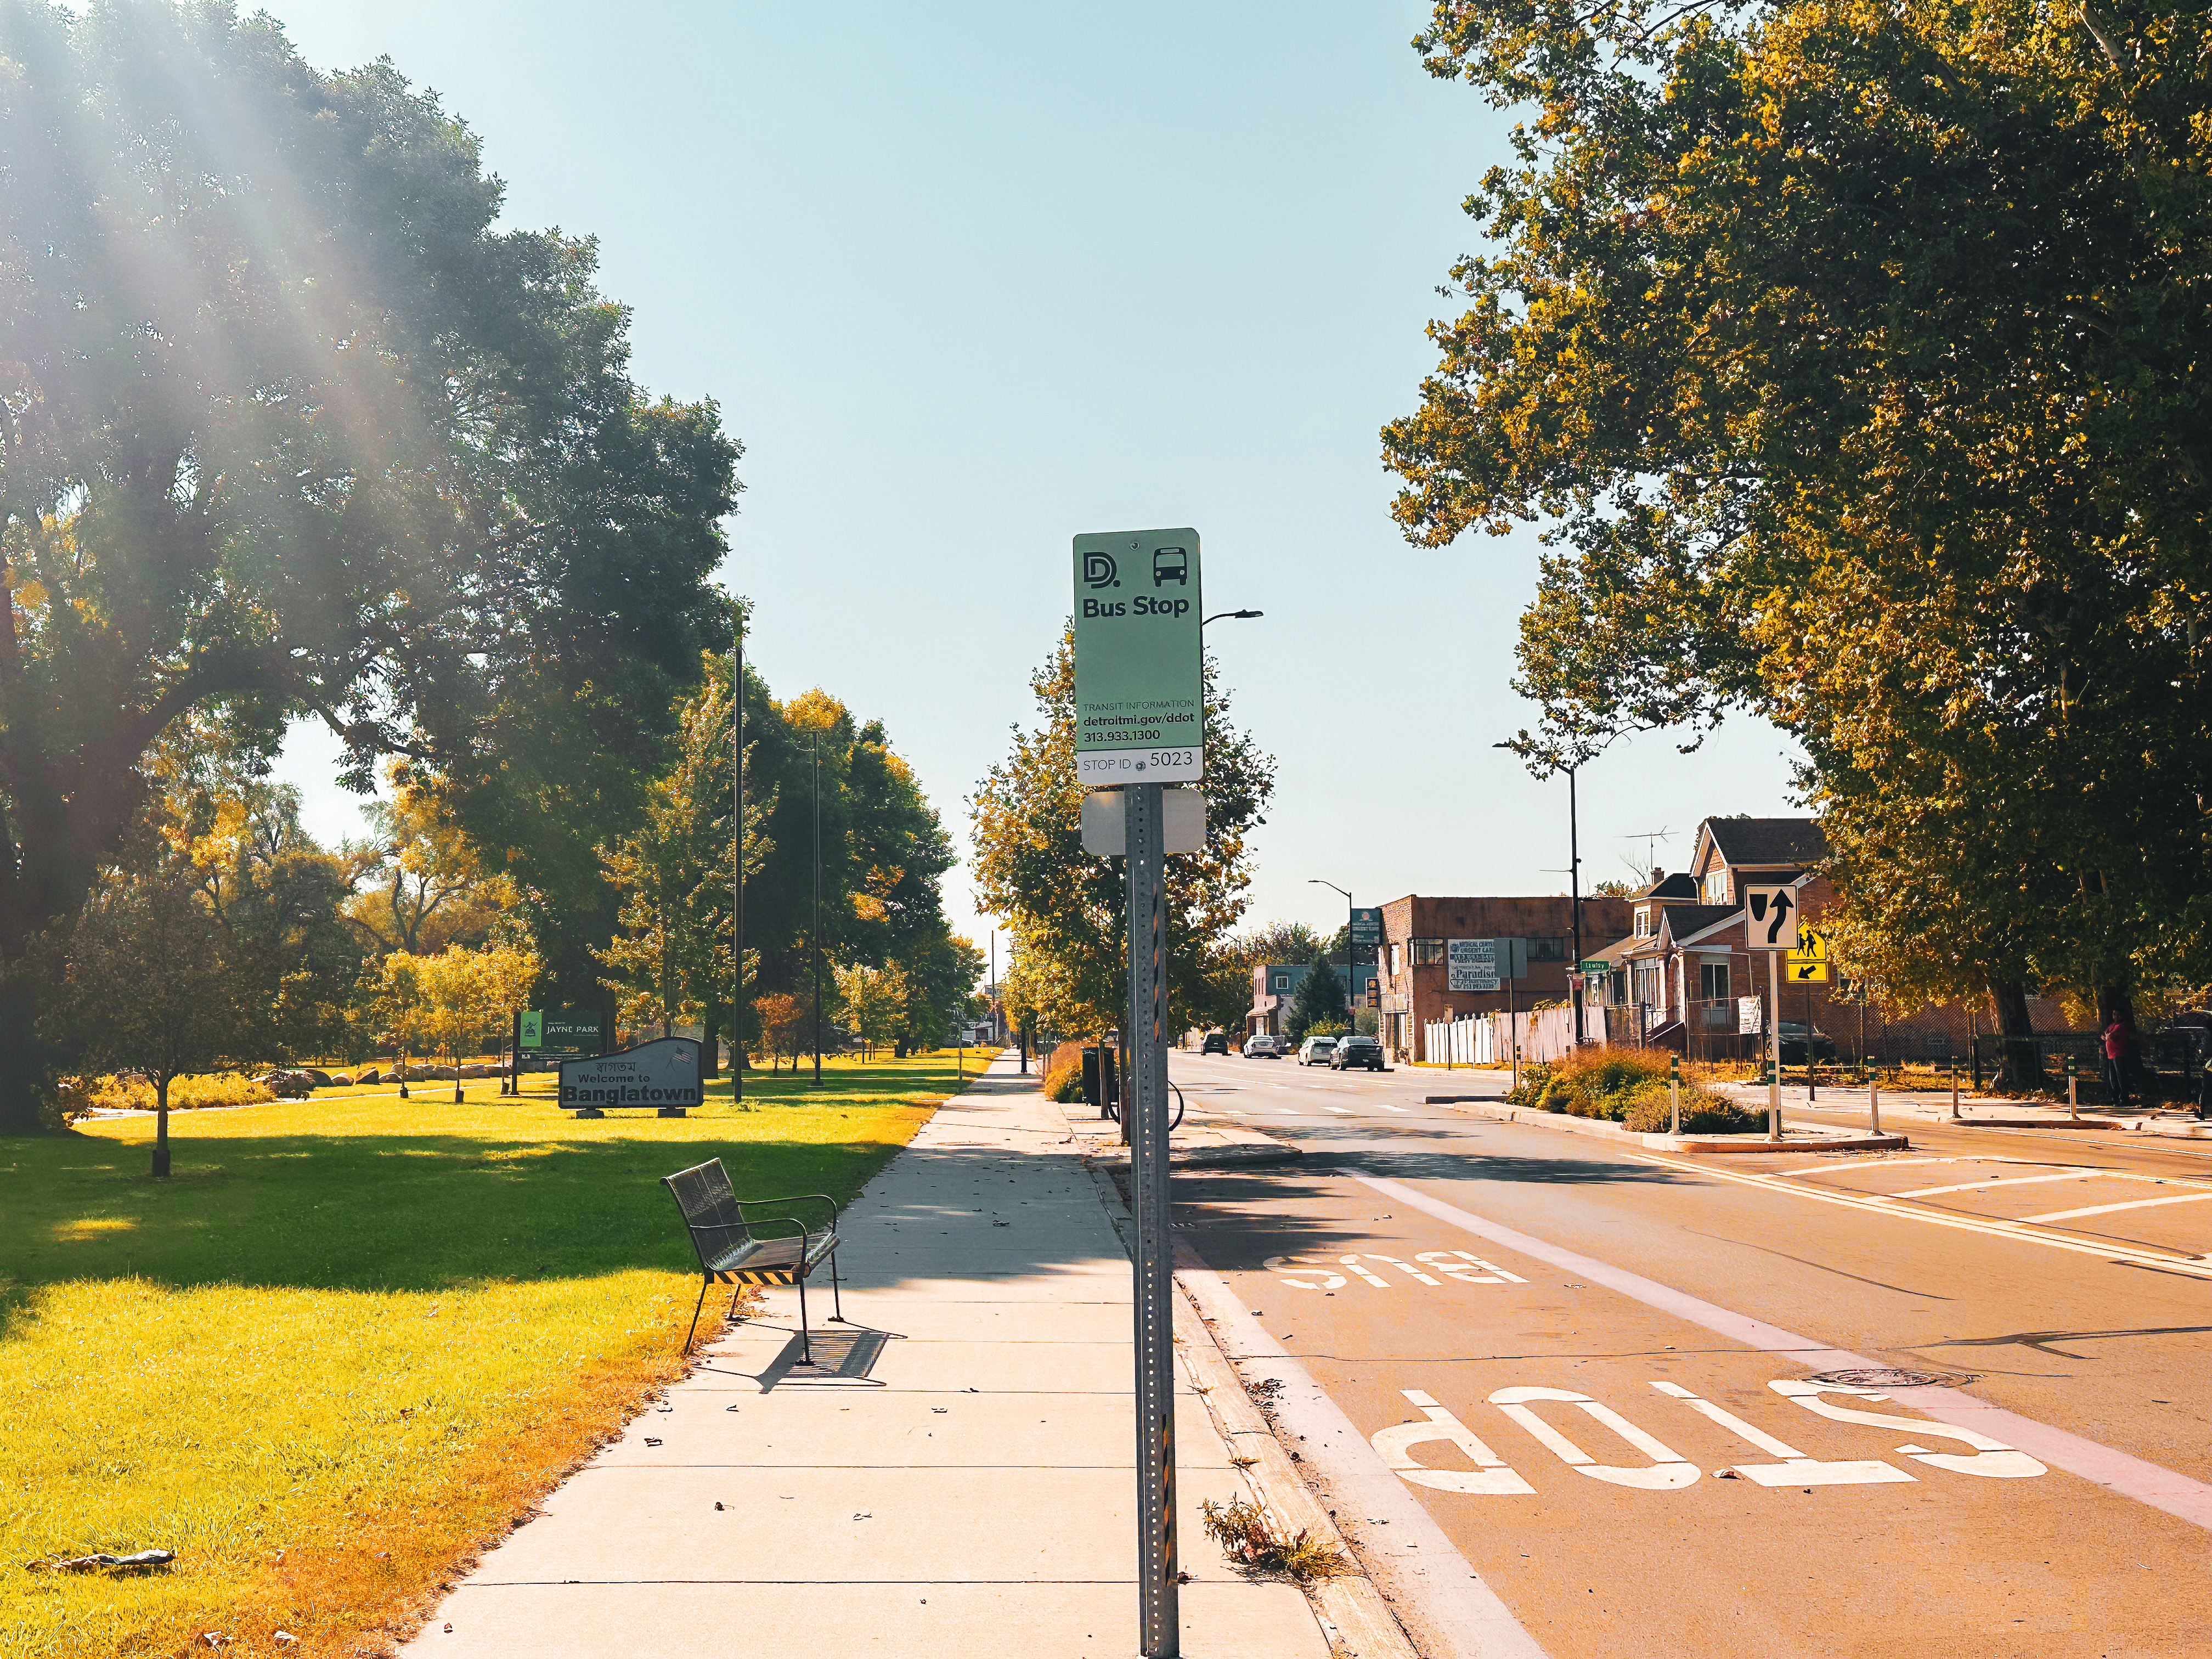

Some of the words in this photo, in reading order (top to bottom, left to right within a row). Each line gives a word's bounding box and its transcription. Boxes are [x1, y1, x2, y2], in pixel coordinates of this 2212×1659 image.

[1083, 599, 1126, 618] Bus
[1133, 596, 1189, 618] Stop
[1084, 702, 1123, 712] TRANSIT
[1126, 699, 1194, 710] INFORMATION
[1084, 712, 1195, 726] detroitmi.gov/ddot
[1084, 730, 1161, 742] 313.933.1300
[1084, 759, 1115, 770] STOP
[1119, 759, 1131, 769] ID
[1150, 751, 1193, 766] 5023
[546, 1026, 573, 1034] JAYNE
[578, 1074, 634, 1083] Welcome
[638, 1074, 650, 1082] to
[562, 1085, 696, 1104] Banglatown
[1262, 1250, 1531, 1290] BUS
[1370, 1379, 2047, 1495] STOP
